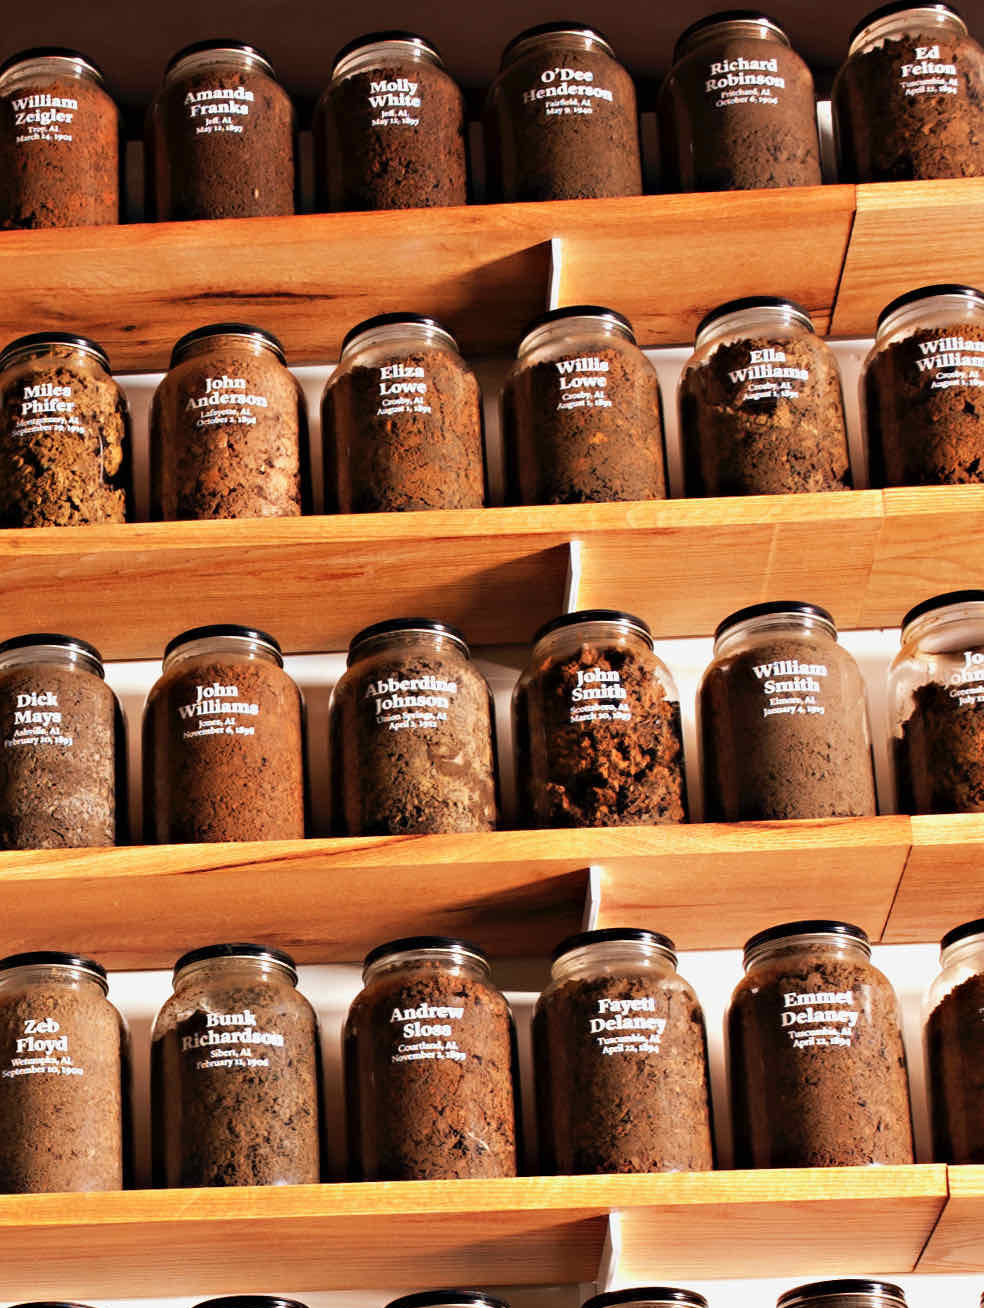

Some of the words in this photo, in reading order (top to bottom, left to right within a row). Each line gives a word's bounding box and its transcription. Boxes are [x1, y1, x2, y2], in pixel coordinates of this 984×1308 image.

[915, 46, 940, 60] Ed
[710, 57, 778, 75] Richard
[901, 62, 957, 78] Felton
[541, 68, 593, 83] O'Dee
[705, 72, 785, 92] Robinson
[369, 79, 417, 94] Molly
[523, 82, 613, 103] Henderson
[11, 94, 78, 110] William
[184, 87, 254, 104] Amanda
[368, 94, 421, 108] White
[15, 109, 73, 125] Zeigler
[190, 101, 249, 117] Franks
[749, 348, 786, 364] Ella
[380, 365, 425, 380] Eliza
[728, 365, 809, 383] Williams
[23, 384, 72, 399] Miles
[205, 376, 246, 393] John
[379, 381, 427, 396] Lowe
[559, 376, 607, 390] Lowe
[21, 398, 75, 415] Phifer
[185, 391, 267, 411] Anderson
[576, 668, 620, 686] John
[752, 660, 828, 679] William
[196, 683, 239, 700] John
[571, 684, 627, 701] Smith
[764, 676, 820, 695] Smith
[17, 692, 58, 707] Dick
[376, 694, 449, 714] Johnson
[14, 710, 62, 726] Mays
[178, 700, 259, 719] Williams
[206, 1009, 257, 1028] Bunk
[390, 1003, 464, 1022] Andrew
[781, 1008, 858, 1027] Delaney
[23, 1018, 59, 1033] Zeb
[589, 1014, 666, 1034] Delaney
[15, 1036, 67, 1055] Floyd
[182, 1028, 284, 1049] Richardson
